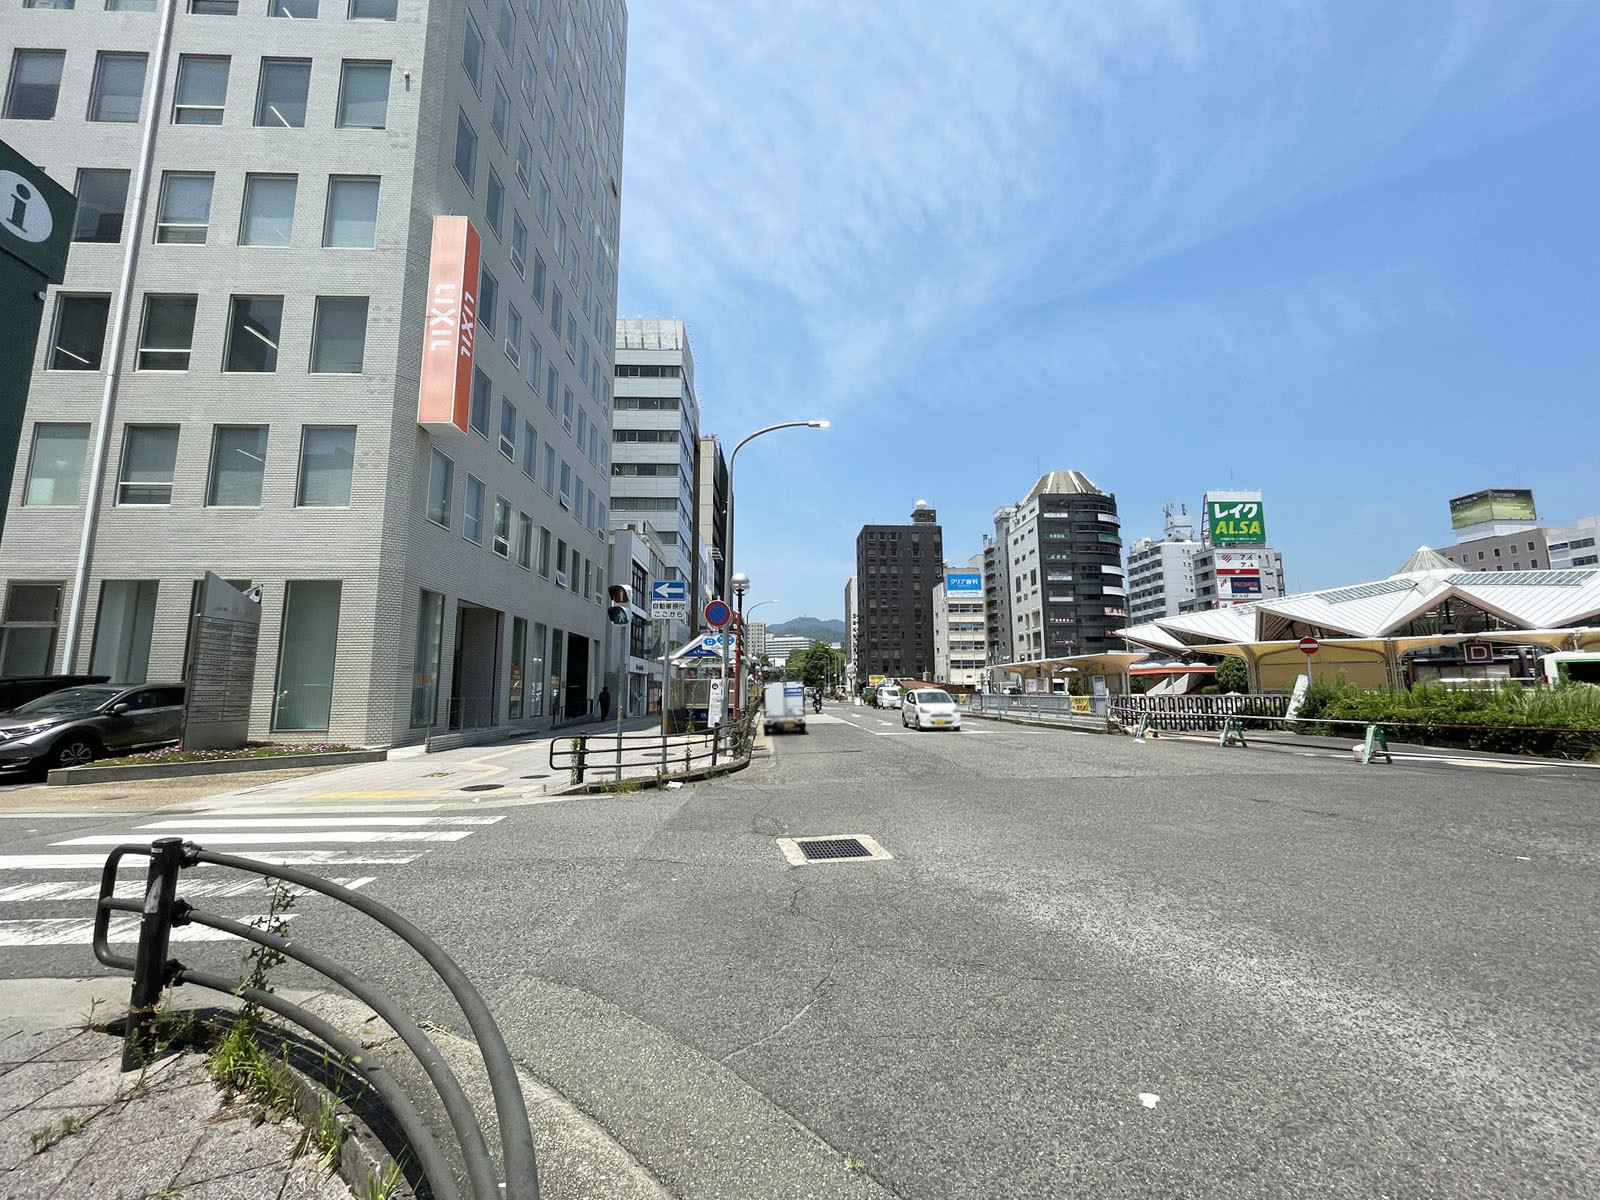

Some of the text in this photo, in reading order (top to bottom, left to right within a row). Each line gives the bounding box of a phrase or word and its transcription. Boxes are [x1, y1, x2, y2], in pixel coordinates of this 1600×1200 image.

[430, 284, 456, 351] LIXIL
[461, 291, 475, 358] LIXIL
[1214, 503, 1258, 519] レイク
[1215, 520, 1261, 535] ALSA
